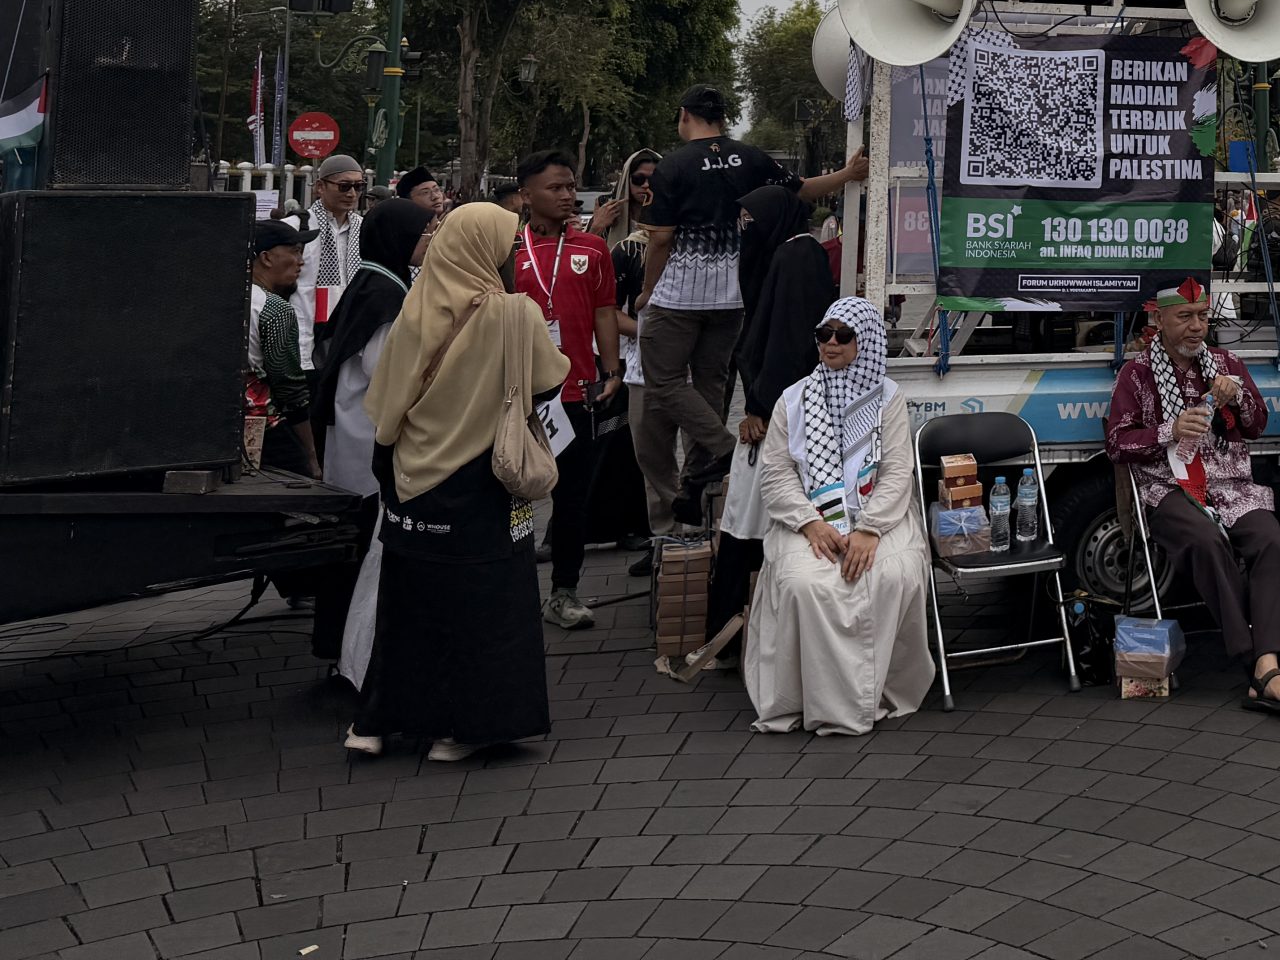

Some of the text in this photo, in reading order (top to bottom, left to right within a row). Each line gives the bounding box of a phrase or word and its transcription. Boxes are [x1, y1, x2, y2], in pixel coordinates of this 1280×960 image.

[1110, 59, 1188, 81] BERIKAN
[1110, 84, 1178, 106] HADIAH
[1109, 109, 1187, 130] TERBAIK
[1110, 134, 1171, 155] UNTUK
[1109, 158, 1203, 180] PALESTINA
[966, 212, 1014, 238] BSI
[1041, 217, 1189, 243] 130 130 0038
[966, 241, 1031, 250] BANK SYARIAH
[966, 250, 1017, 258] INDONESIA
[1040, 245, 1164, 259] an. INFAQ DUNIA ISLAM
[1022, 279, 1048, 287] FORUM
[1049, 279, 1093, 287] UKHUWWAH
